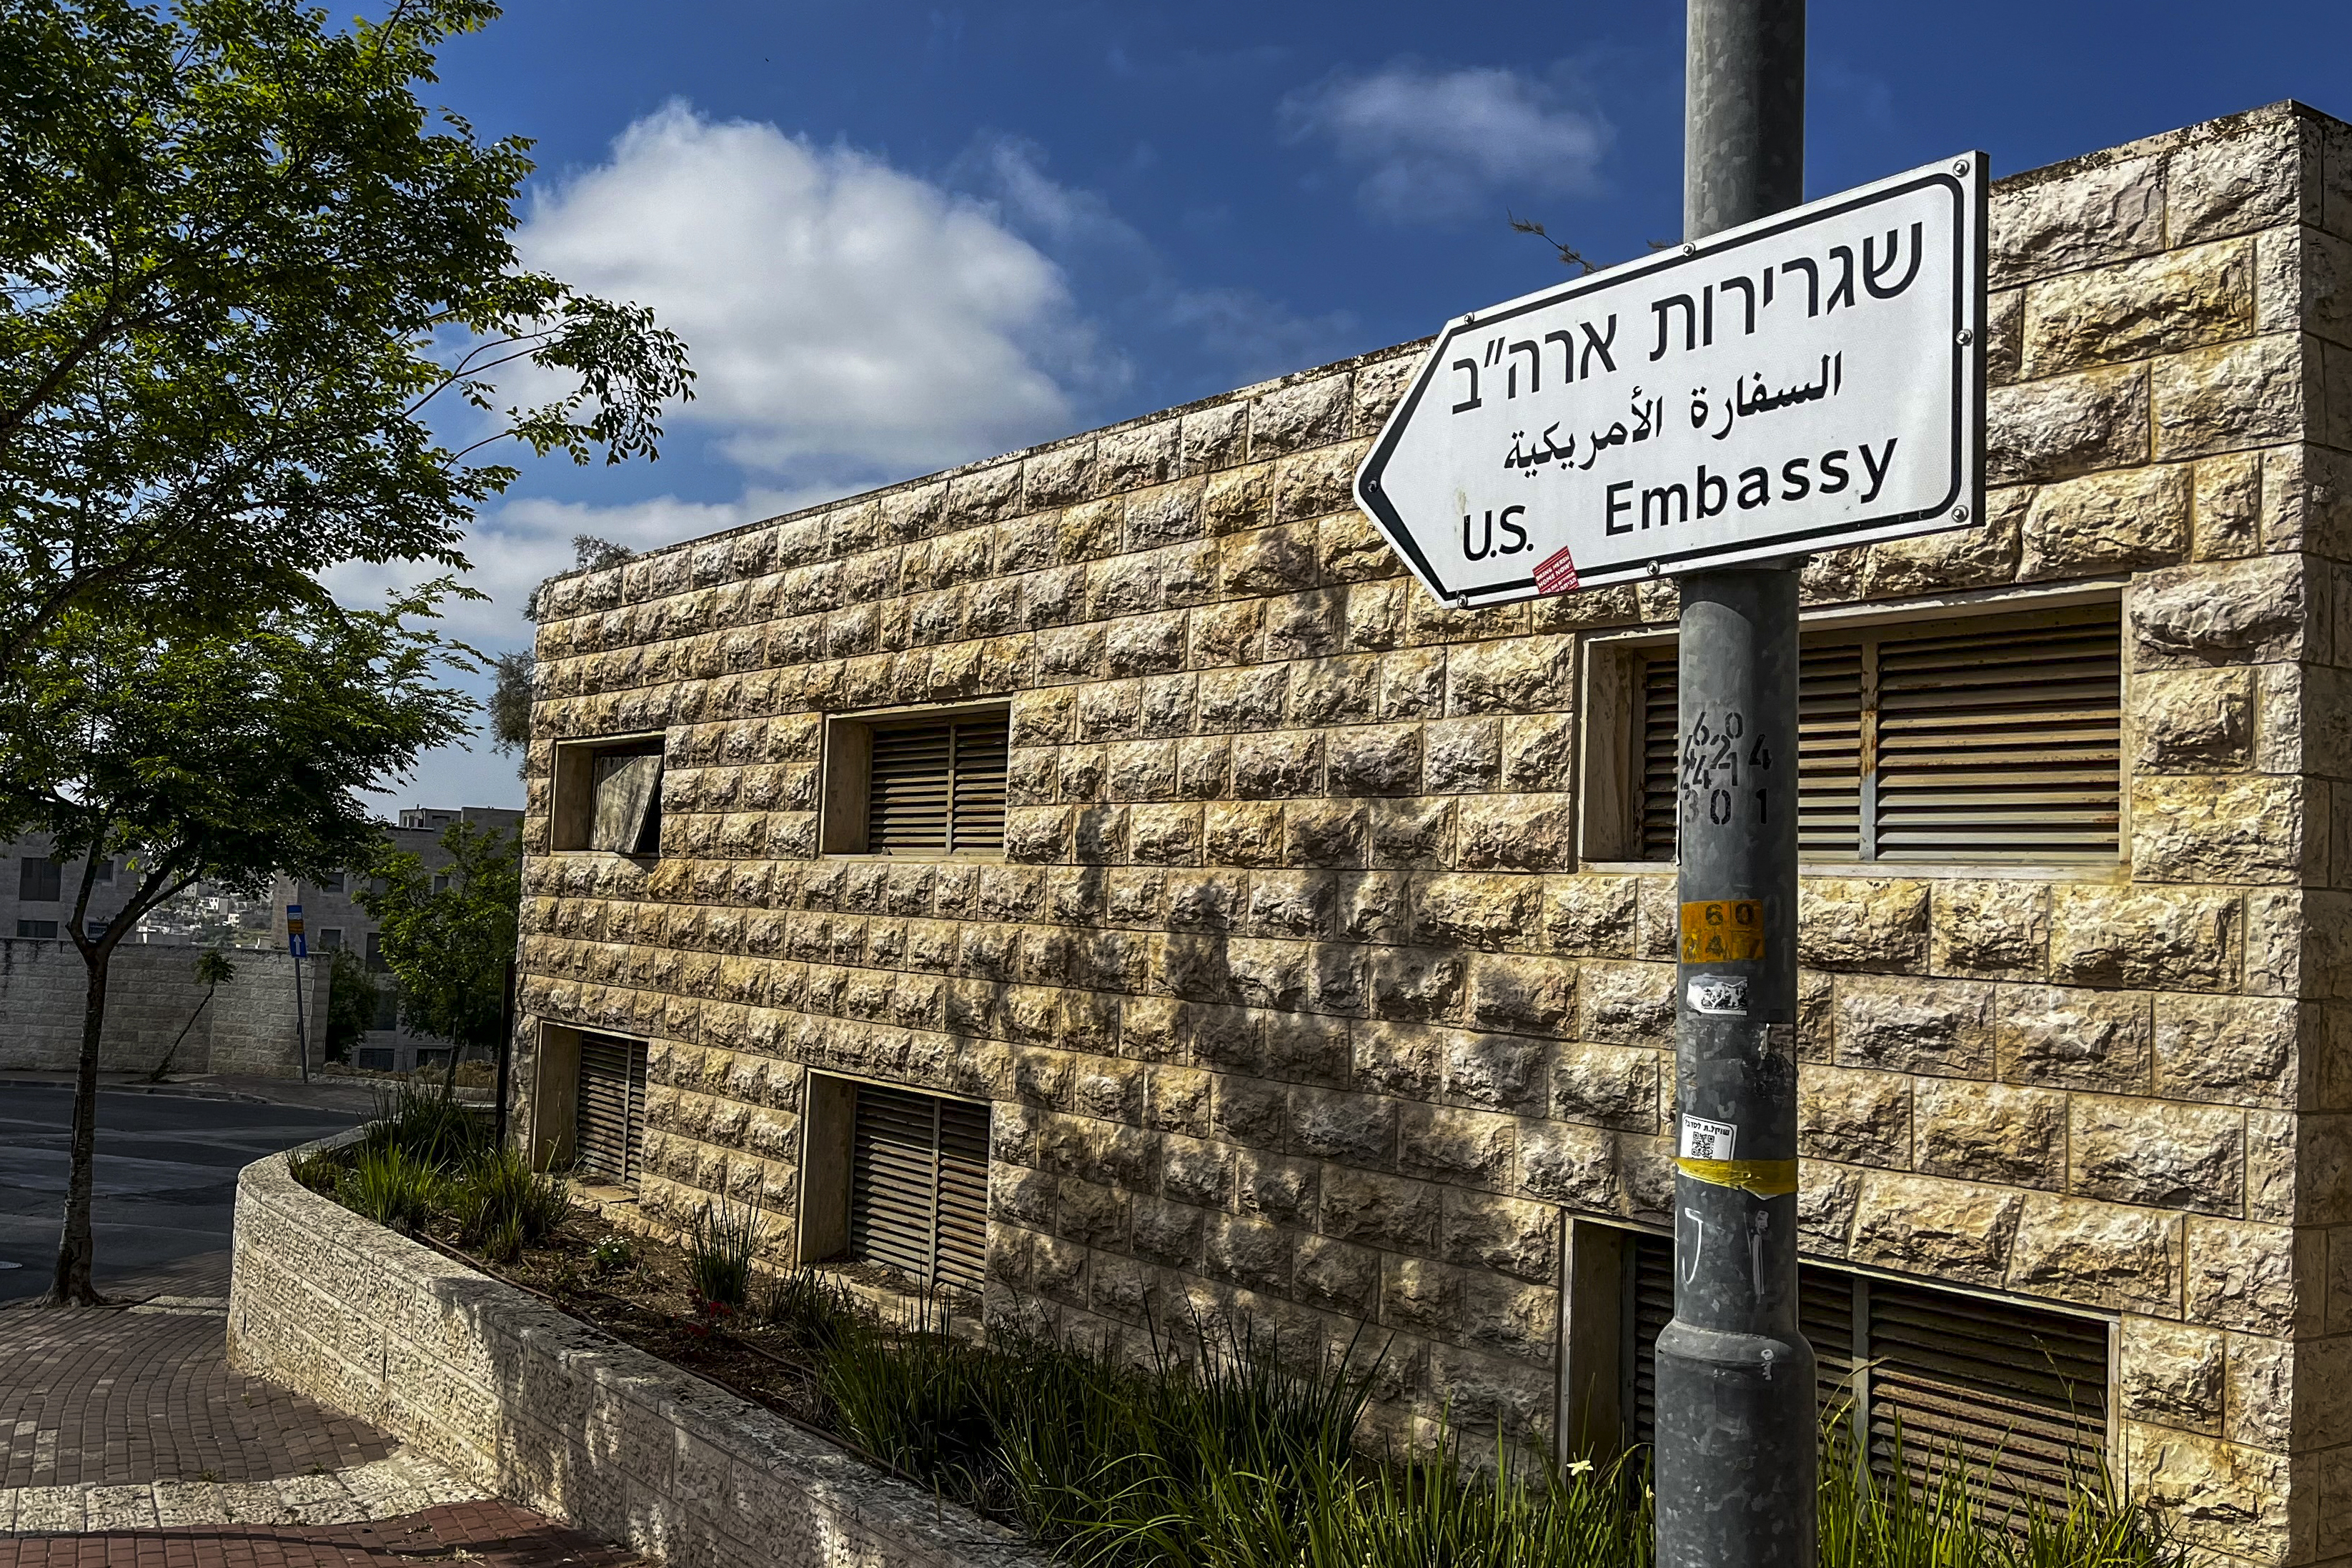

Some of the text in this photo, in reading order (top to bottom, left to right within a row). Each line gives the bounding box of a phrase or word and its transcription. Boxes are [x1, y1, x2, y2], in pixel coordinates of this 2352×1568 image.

[1649, 221, 1922, 362] שגרירות
[1504, 350, 1842, 479] السفارة الأمريكية
[1463, 437, 1898, 561] U.S. Embassy
[1536, 567, 1552, 582] BRING
[1538, 561, 1572, 588] HOME NOW!
